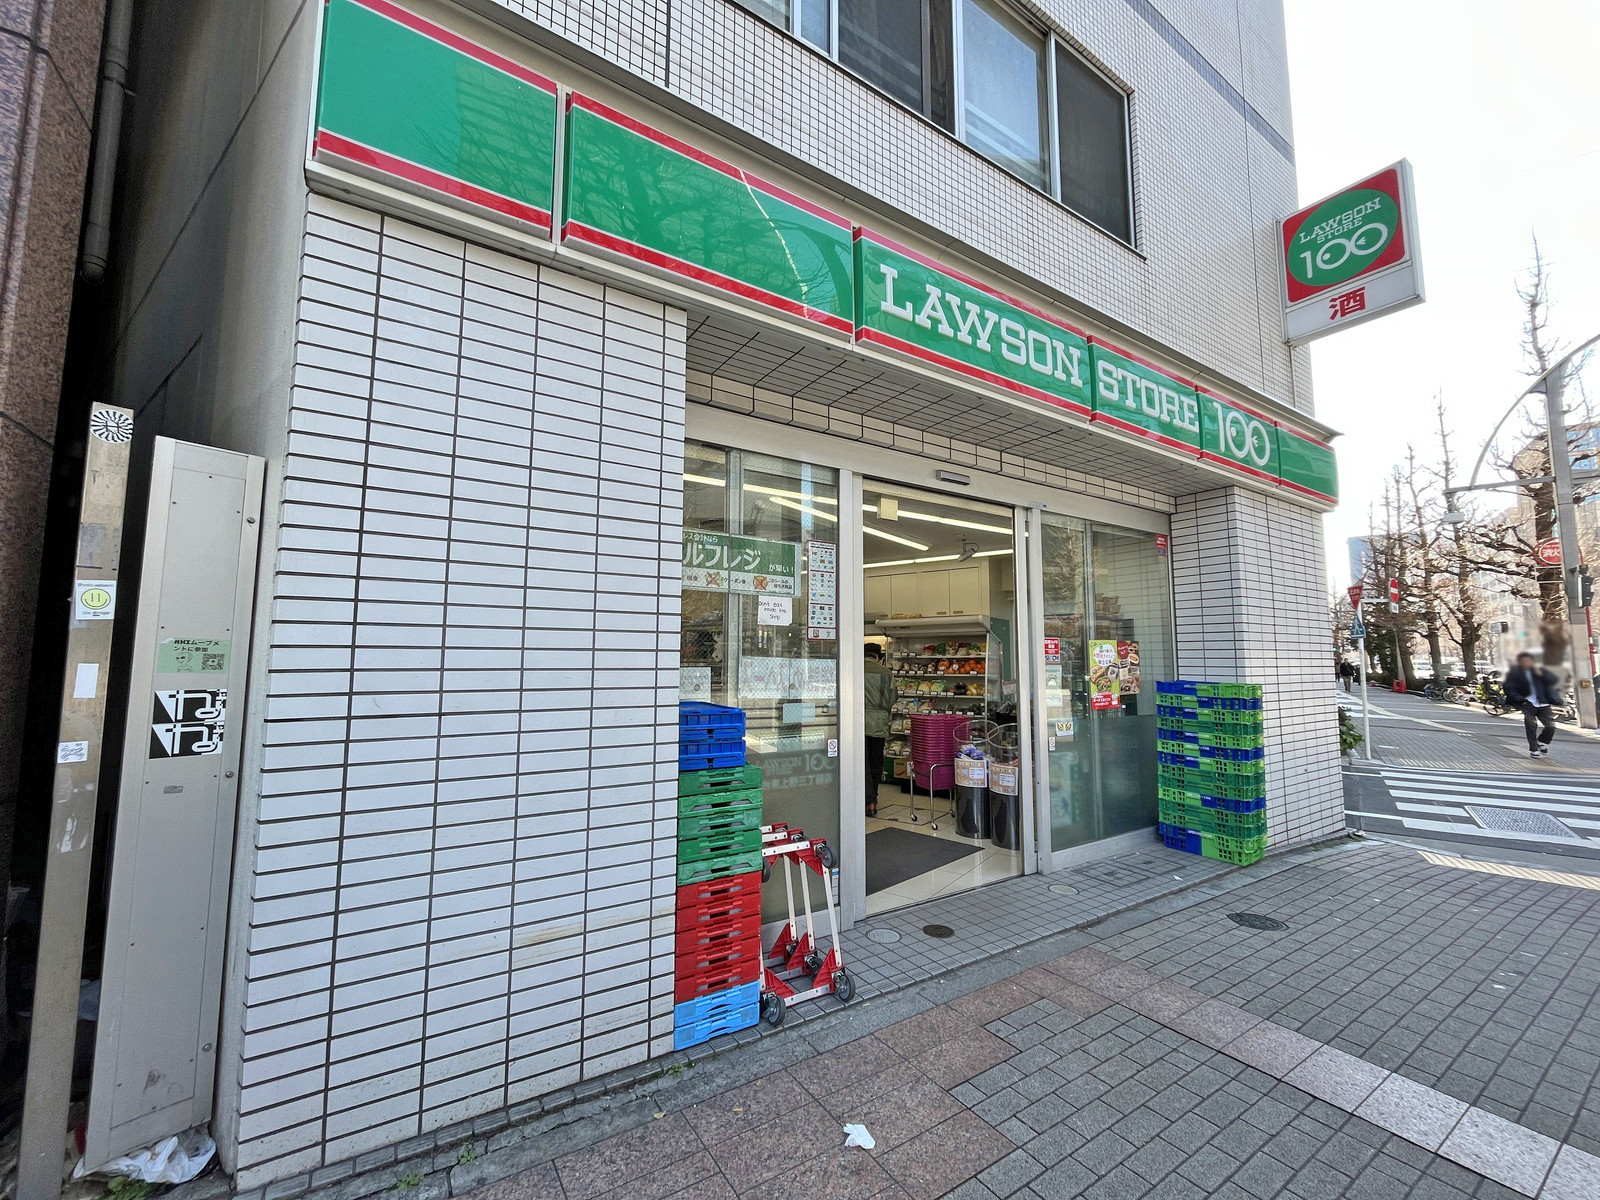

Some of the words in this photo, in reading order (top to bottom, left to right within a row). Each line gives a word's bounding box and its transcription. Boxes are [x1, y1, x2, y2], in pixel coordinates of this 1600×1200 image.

[1299, 197, 1382, 244] LAWSON
[1316, 217, 1363, 243] STORE
[1300, 222, 1389, 279] 100
[1329, 286, 1366, 320] 酒
[879, 264, 1083, 388] LAWSON
[1097, 358, 1200, 432] STORE
[1212, 401, 1271, 467] 100
[683, 532, 718, 543] レス会計なら
[1542, 548, 1561, 558] 消火
[682, 542, 761, 571] ルフレジ
